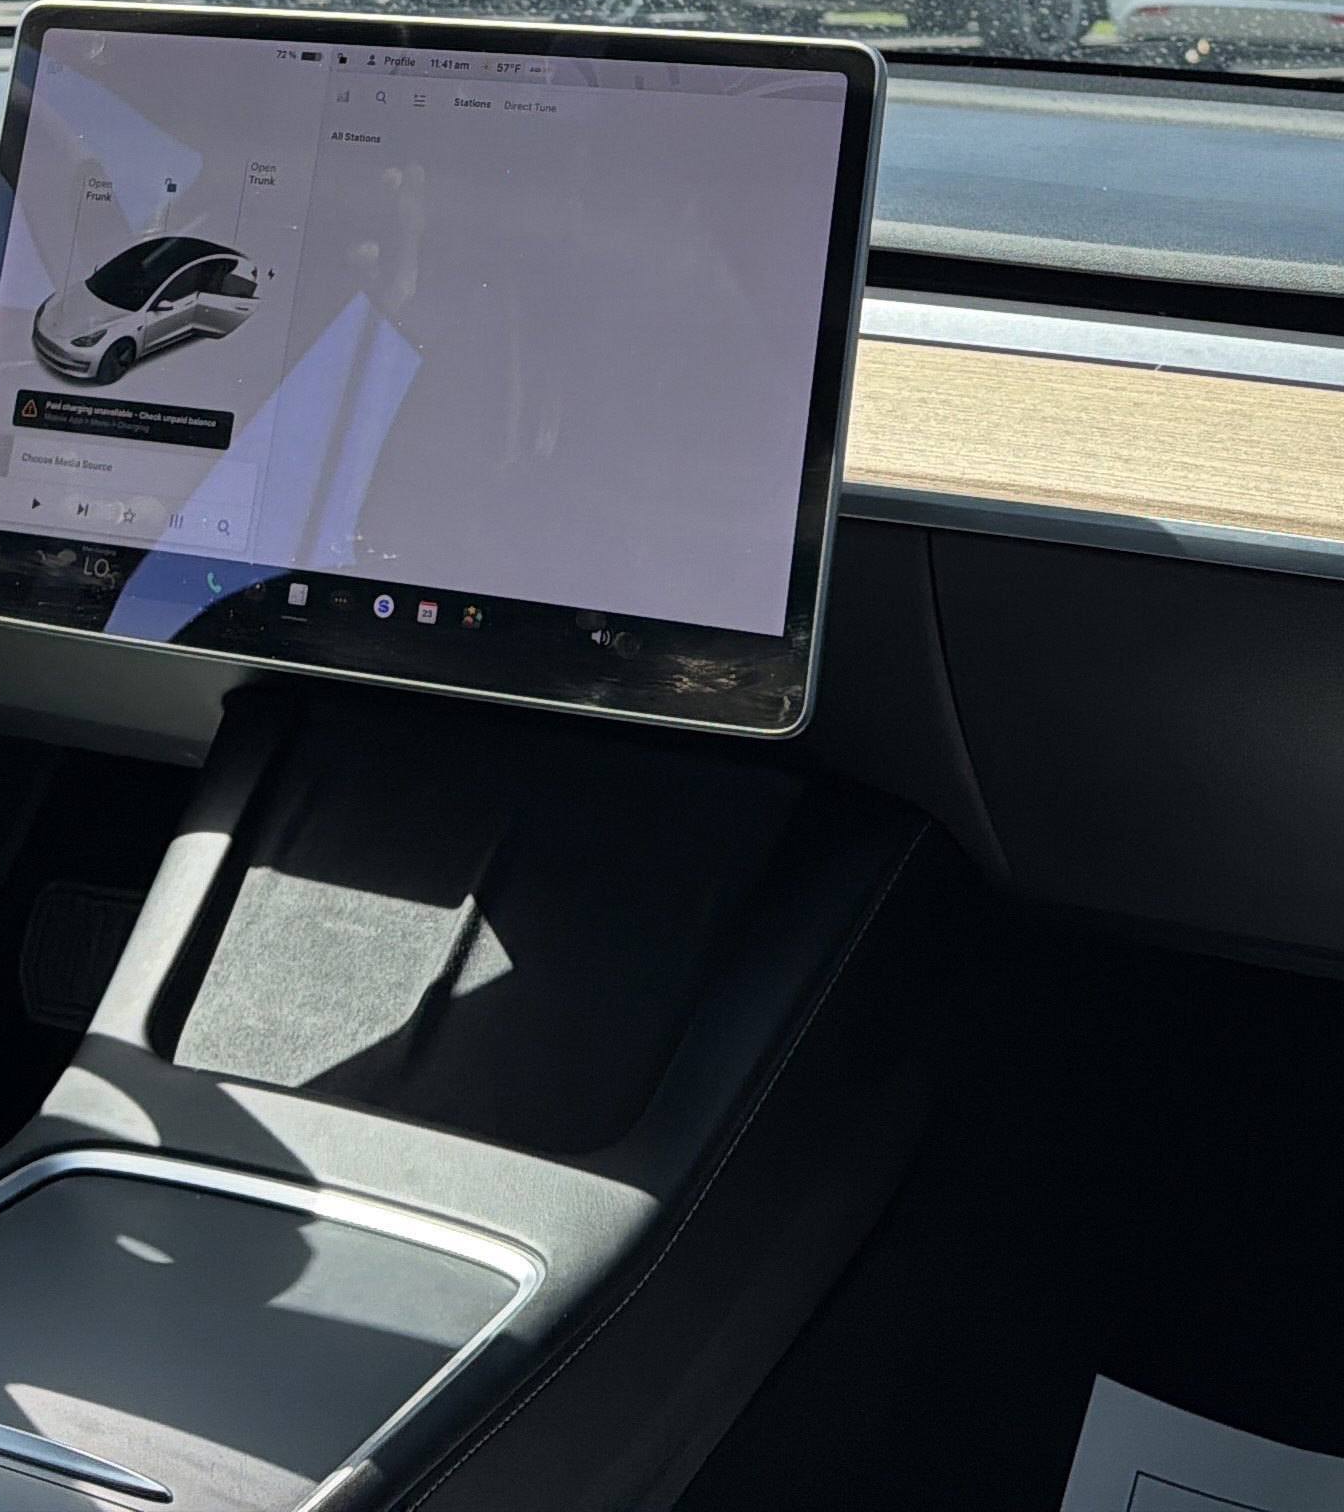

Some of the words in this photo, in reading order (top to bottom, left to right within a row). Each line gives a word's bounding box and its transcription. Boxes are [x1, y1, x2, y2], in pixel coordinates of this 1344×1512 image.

[384, 55, 416, 66] Profile
[454, 97, 492, 109] Stations
[503, 100, 532, 111] Direct
[534, 102, 557, 113] Tune
[331, 130, 344, 141] All
[344, 131, 381, 144] Stations
[250, 161, 277, 174] Open
[88, 177, 113, 190] Open
[248, 175, 276, 186] Trunk
[85, 190, 112, 202] Frunk
[81, 458, 113, 472] Source
[421, 609, 433, 619] 23
